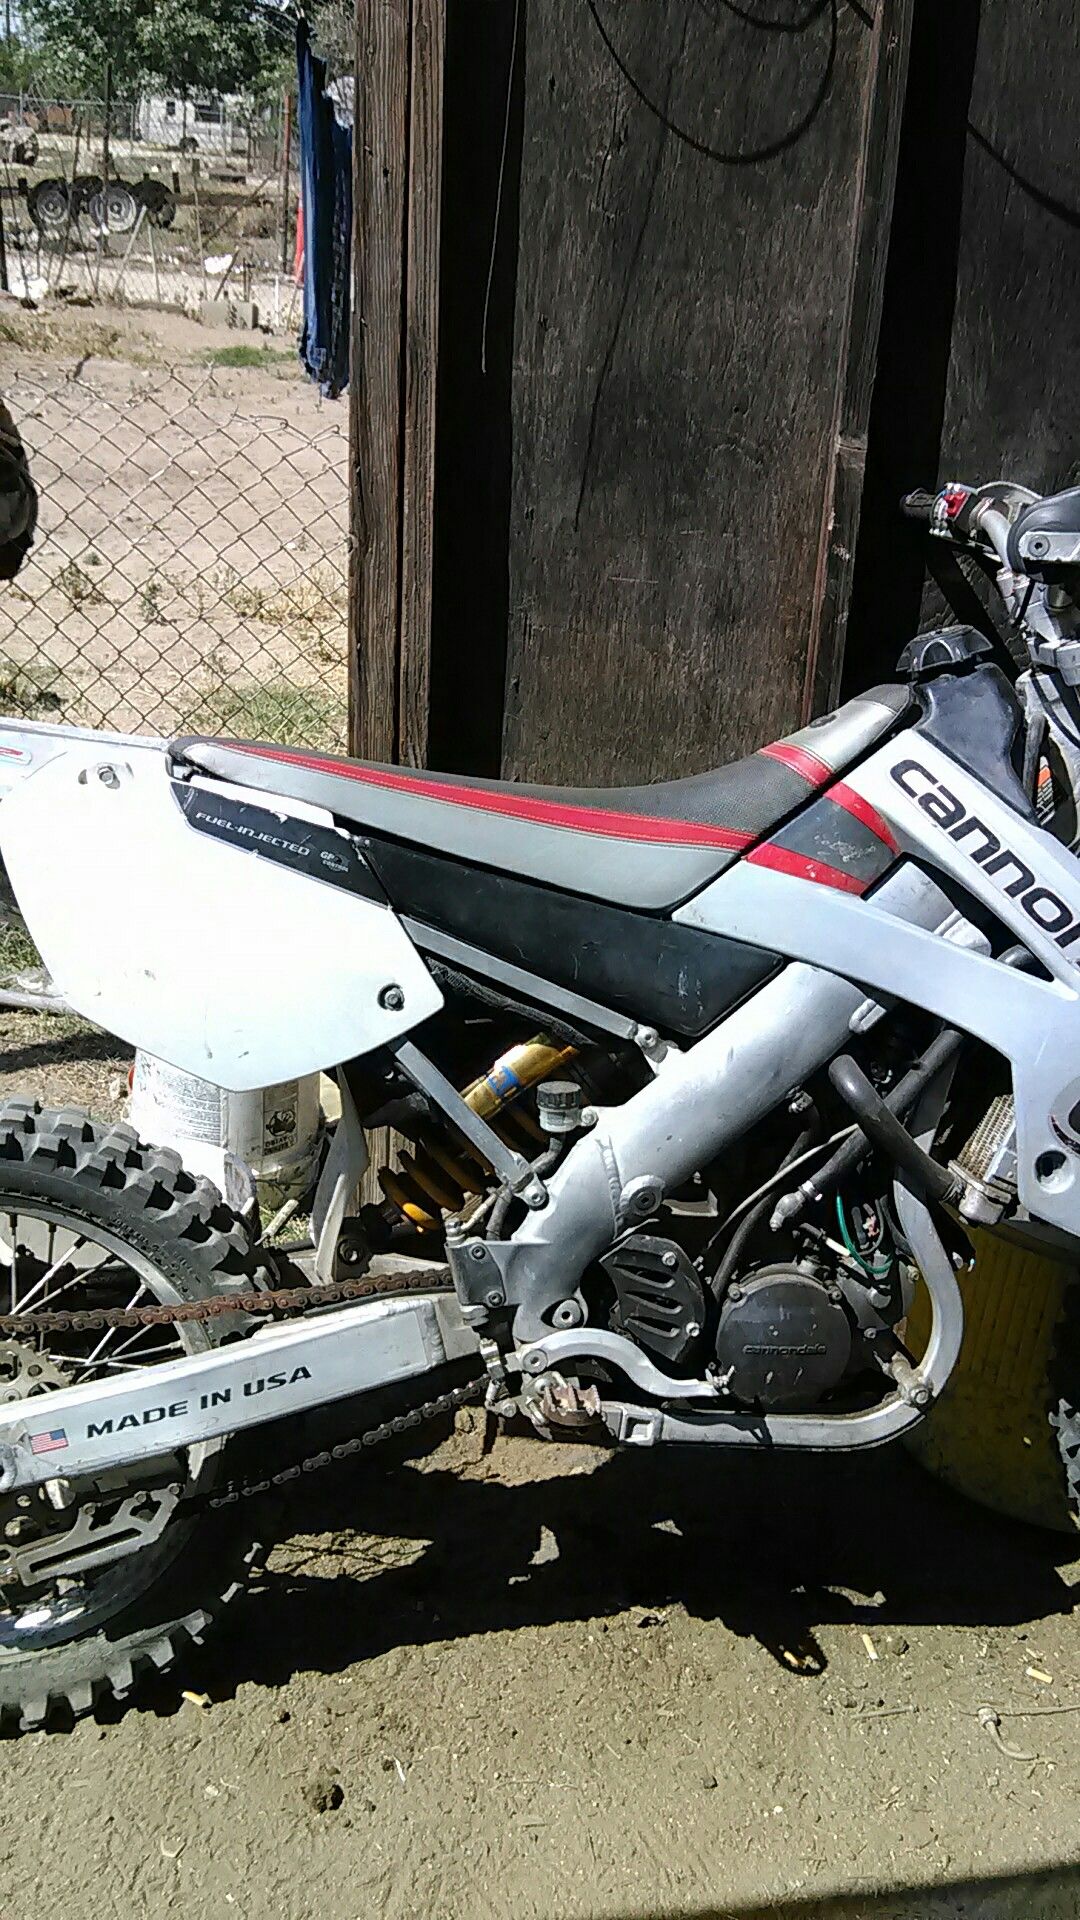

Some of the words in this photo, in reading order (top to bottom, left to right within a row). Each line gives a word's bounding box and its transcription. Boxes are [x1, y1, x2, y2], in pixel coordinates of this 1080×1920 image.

[195, 812, 310, 856] FUEL-INJECTED
[742, 1343, 827, 1356] cannondale
[87, 1400, 189, 1438] MADE
[200, 1388, 231, 1410] IN
[243, 1366, 312, 1397] USA
